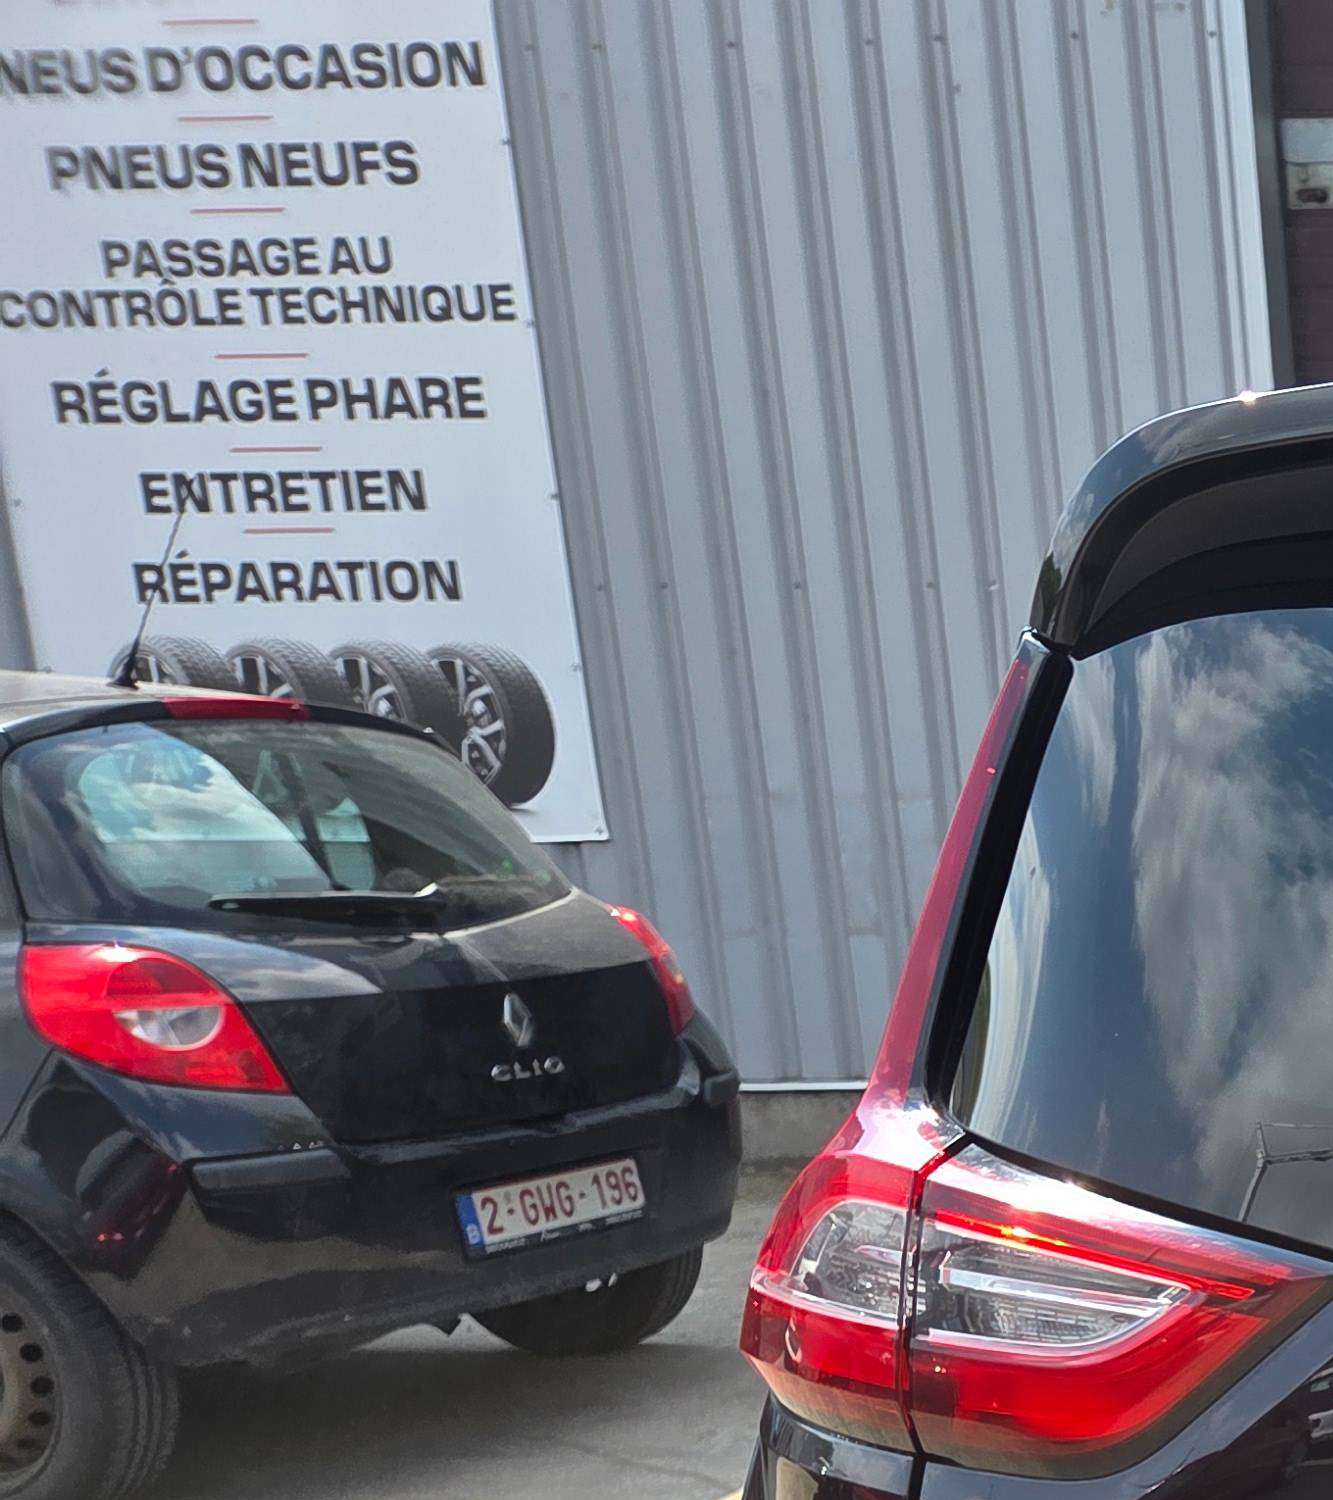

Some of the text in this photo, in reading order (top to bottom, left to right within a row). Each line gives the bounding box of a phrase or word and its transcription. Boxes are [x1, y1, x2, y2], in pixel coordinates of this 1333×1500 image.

[145, 41, 486, 92] D'OCCASION
[46, 140, 419, 189] PNEUS NEUFS
[101, 236, 392, 277] PASSAGE AU
[0, 279, 515, 327] CONTRÔLE TECHNIQUE
[52, 369, 487, 423] RÉGLAGE PHARE
[140, 470, 428, 513] ENTRETIEN
[133, 550, 463, 602] RÉPARATION
[491, 1056, 565, 1081] CLIO
